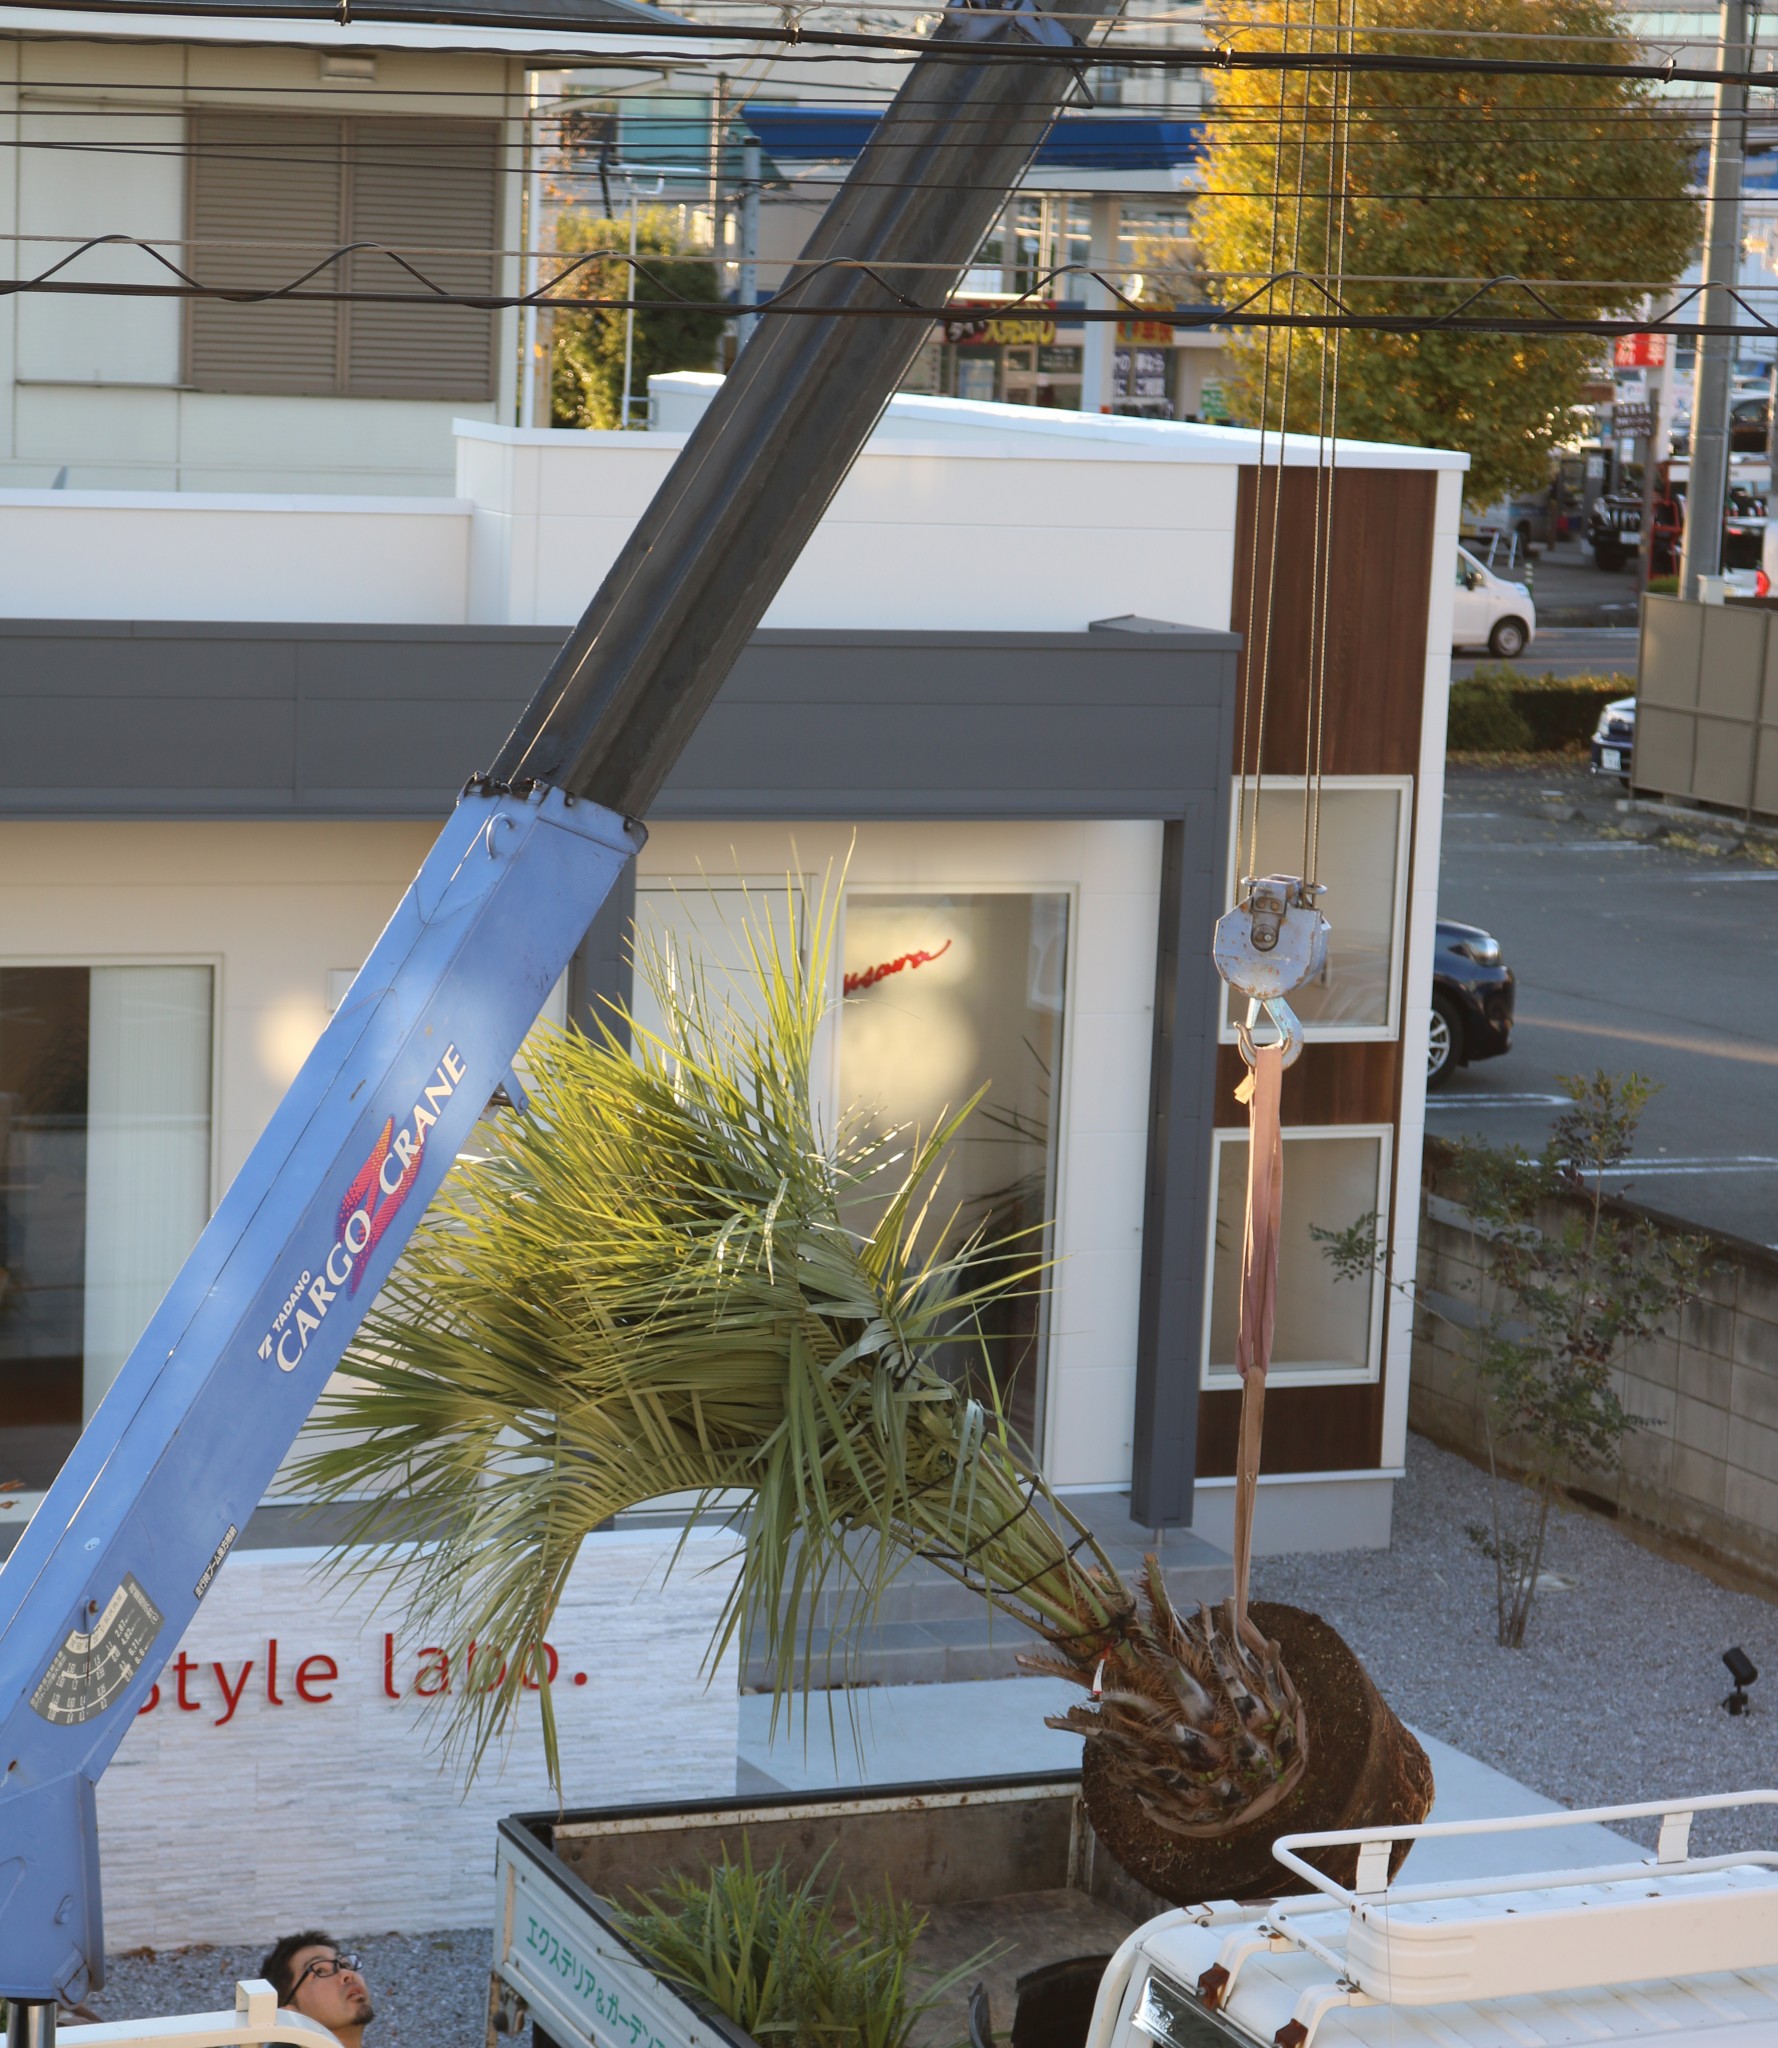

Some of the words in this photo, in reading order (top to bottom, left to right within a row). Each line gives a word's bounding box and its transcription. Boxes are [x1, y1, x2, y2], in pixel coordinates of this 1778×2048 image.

[271, 1270, 311, 1332] TADANO
[276, 1209, 372, 1373] CARGO
[379, 1042, 468, 1195] CRANE
